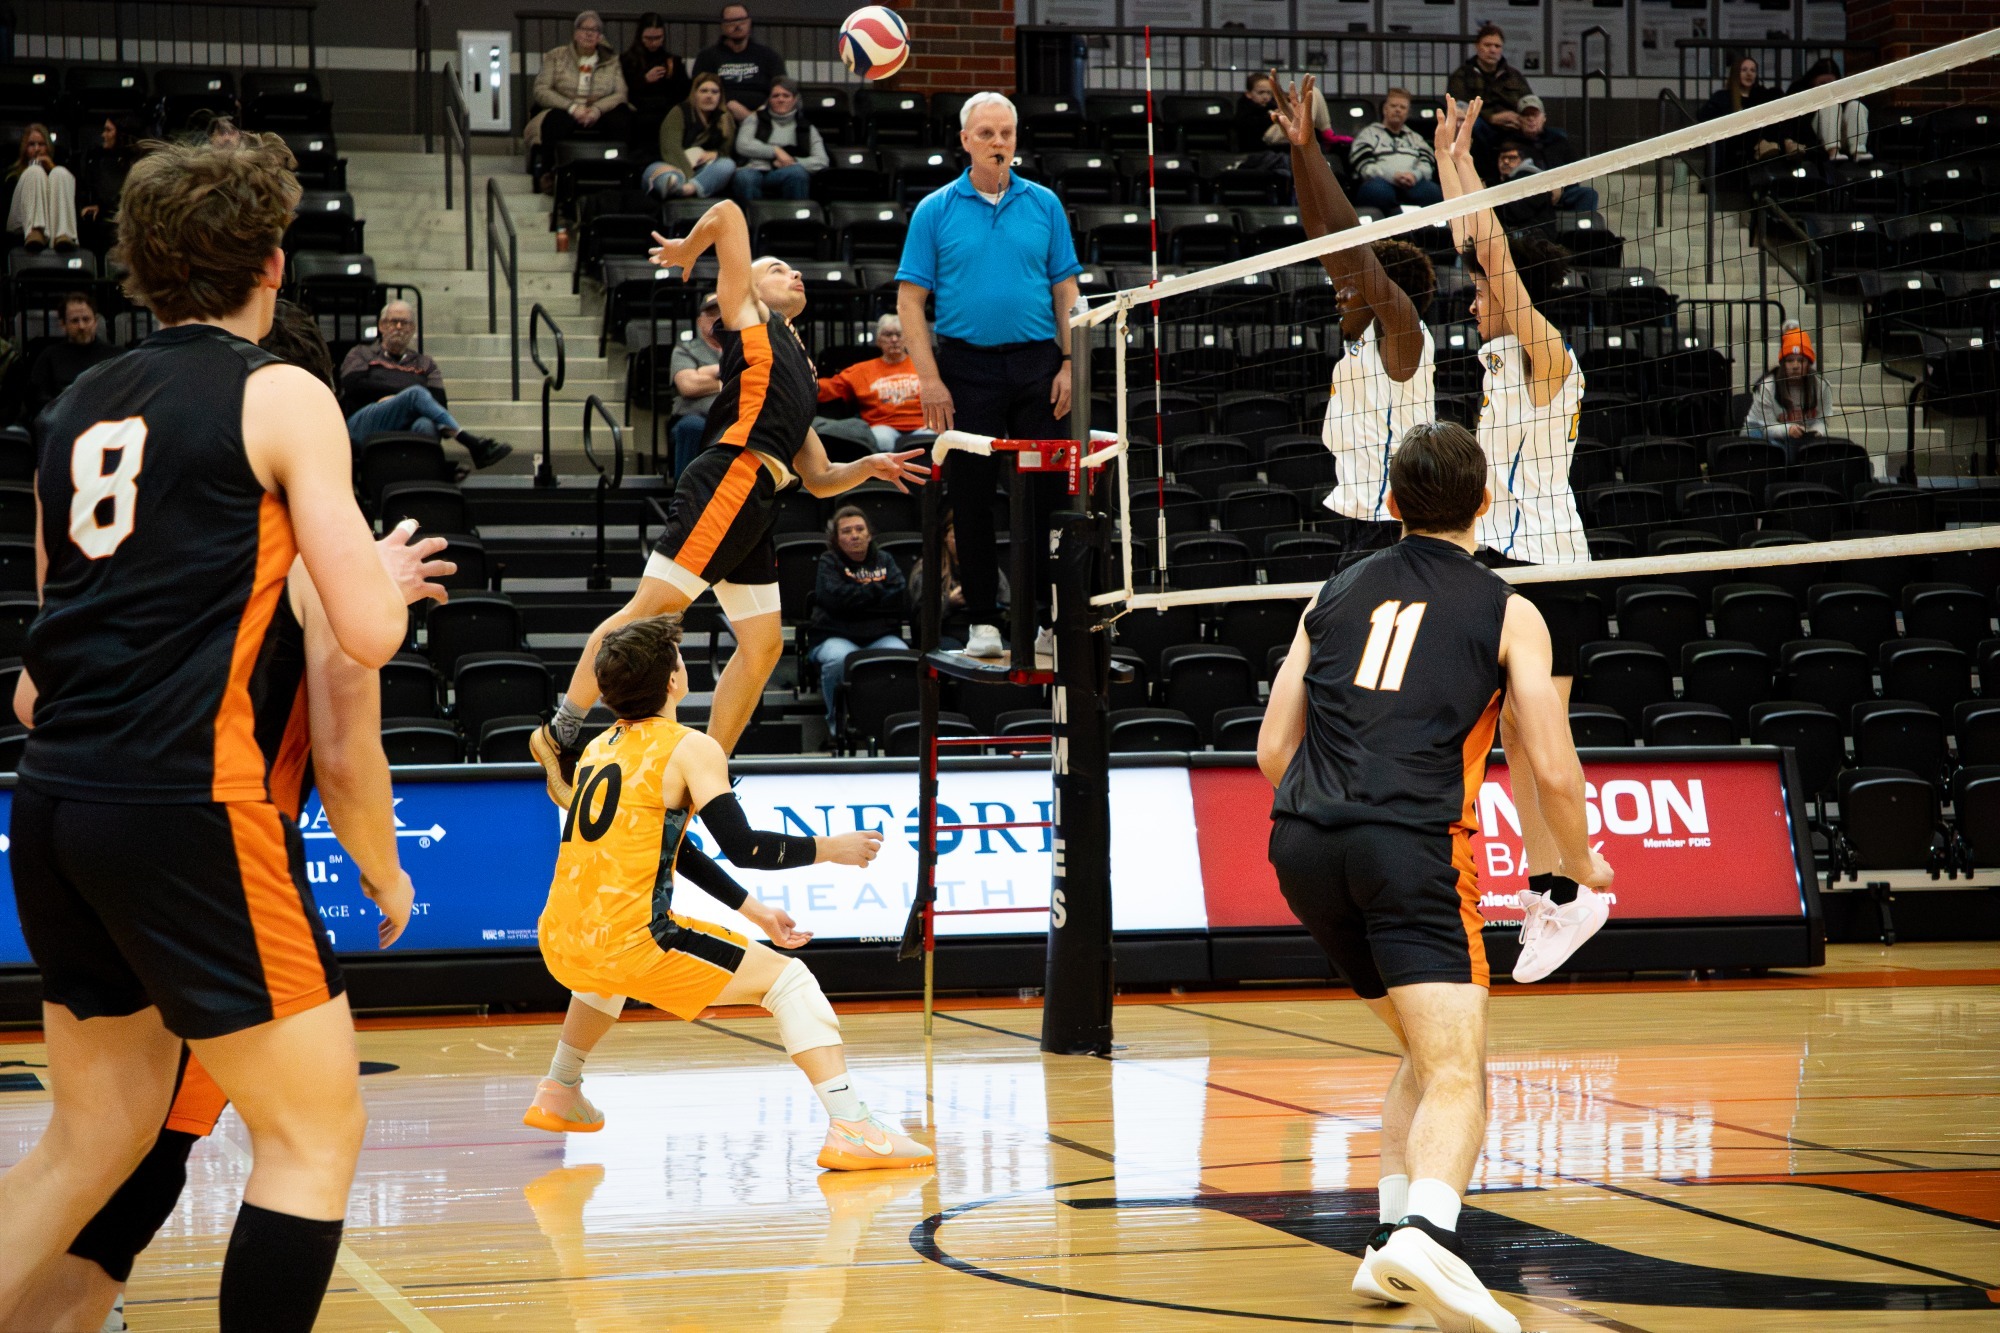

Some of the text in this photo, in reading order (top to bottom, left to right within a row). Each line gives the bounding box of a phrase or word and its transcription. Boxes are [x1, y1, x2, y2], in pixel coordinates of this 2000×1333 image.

[69, 416, 148, 560] 8
[1353, 600, 1427, 691] 11
[562, 763, 622, 842] 10
[1643, 838, 1711, 848] Member FDIC
[756, 880, 1015, 912] HEALTH
[1484, 919, 1523, 928] AKTRON
